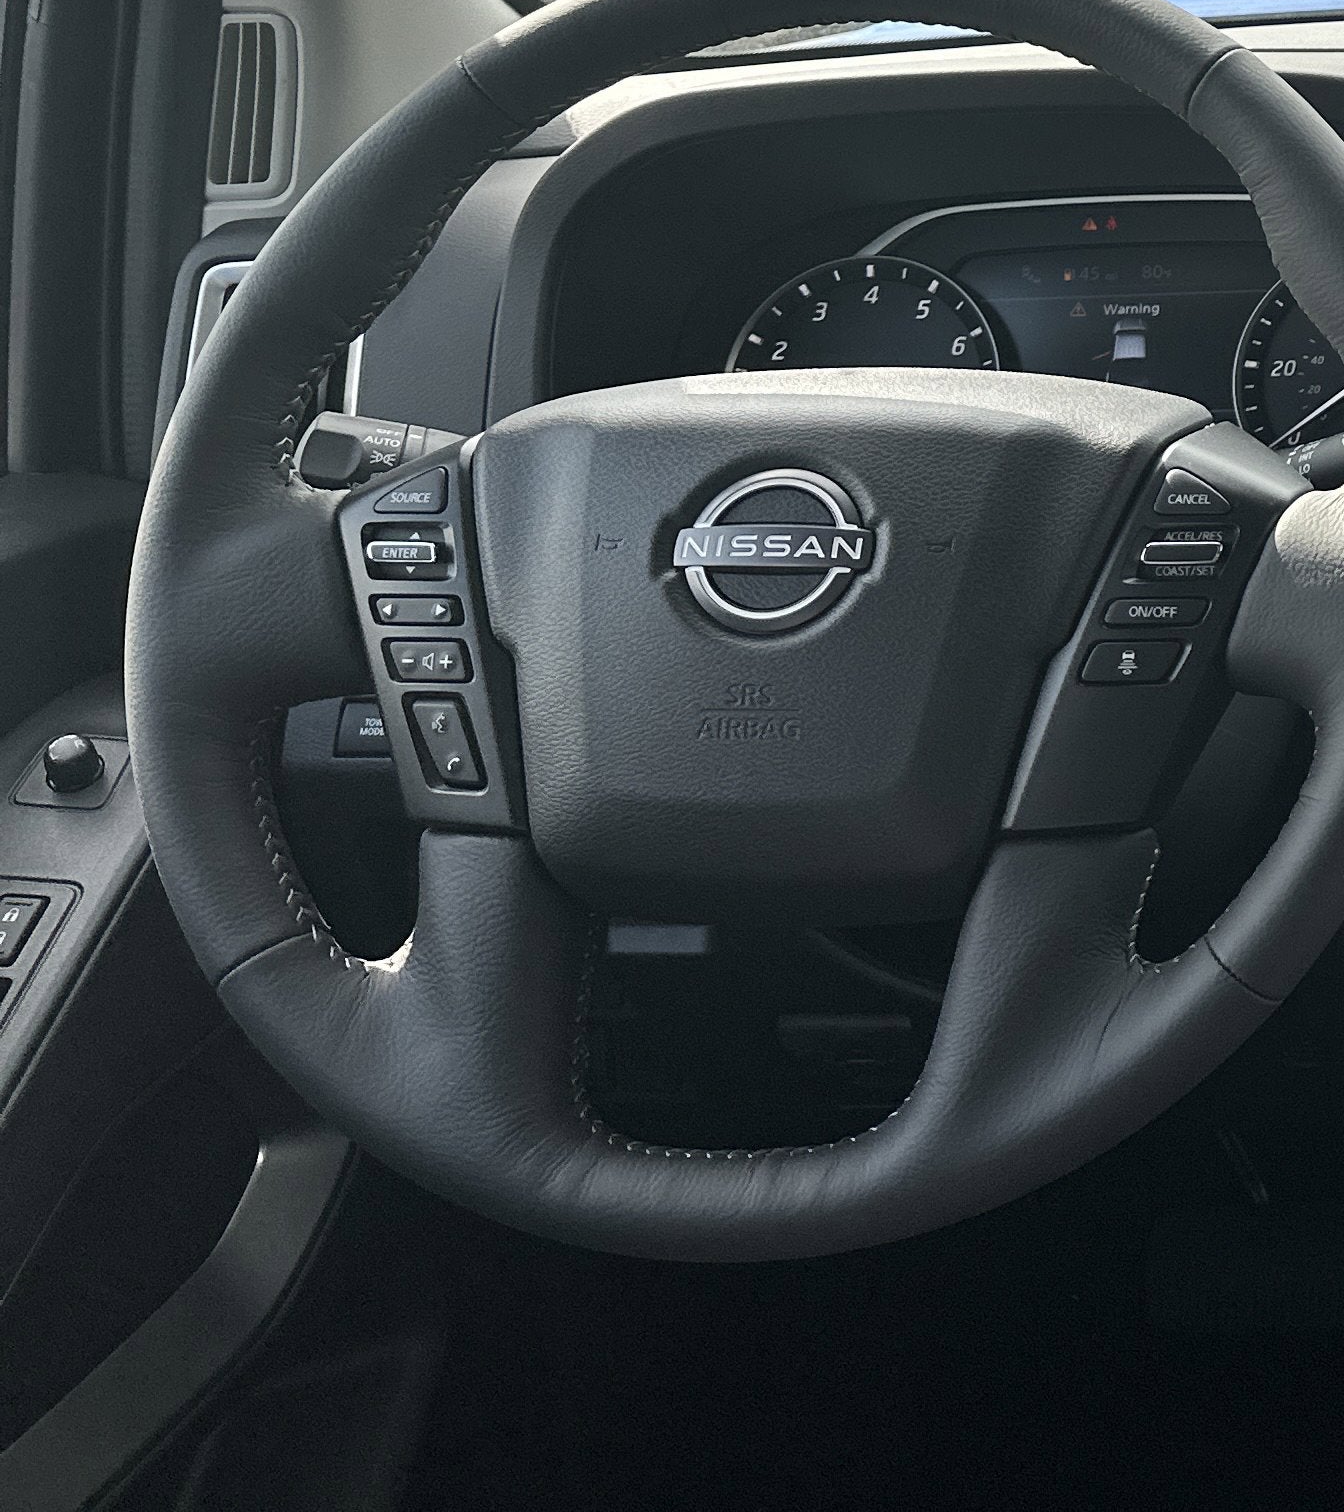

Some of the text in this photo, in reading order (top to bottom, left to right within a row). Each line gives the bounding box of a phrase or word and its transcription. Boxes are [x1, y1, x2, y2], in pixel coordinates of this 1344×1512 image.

[863, 285, 880, 304] 4
[811, 302, 829, 322] 3
[915, 299, 932, 319] 5
[1103, 302, 1161, 317] Warning
[771, 341, 788, 361] 2
[951, 336, 967, 356] 6
[1310, 355, 1325, 366] 40
[1270, 359, 1298, 378] 20
[1307, 384, 1322, 394] 20
[363, 435, 400, 448] AUTO
[390, 491, 432, 504] SOURCE
[1167, 493, 1211, 506] CANCEL
[1163, 529, 1223, 543] ACCEL/RES
[381, 546, 419, 560] ENTER
[680, 532, 865, 562] NISSAN
[1155, 564, 1216, 579] COAST/SET
[1128, 604, 1179, 619] ON/OFF
[724, 683, 774, 707] SRS
[697, 714, 801, 740] AIRBAG
